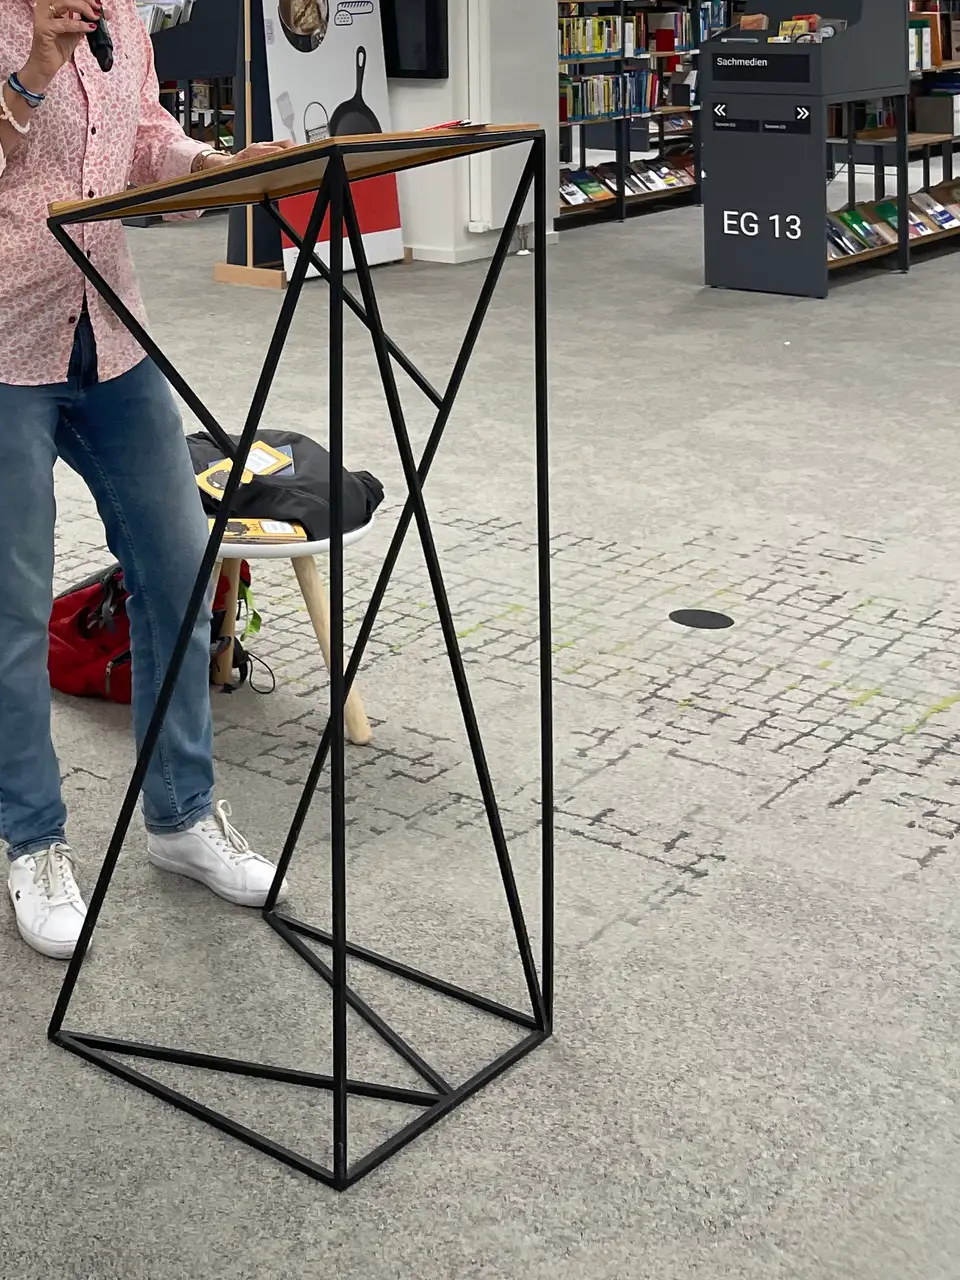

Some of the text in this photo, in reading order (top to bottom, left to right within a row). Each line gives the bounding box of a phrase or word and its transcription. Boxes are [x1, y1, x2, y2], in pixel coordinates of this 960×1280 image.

[716, 57, 768, 67] Sachmedien
[723, 210, 802, 240] EG 13
